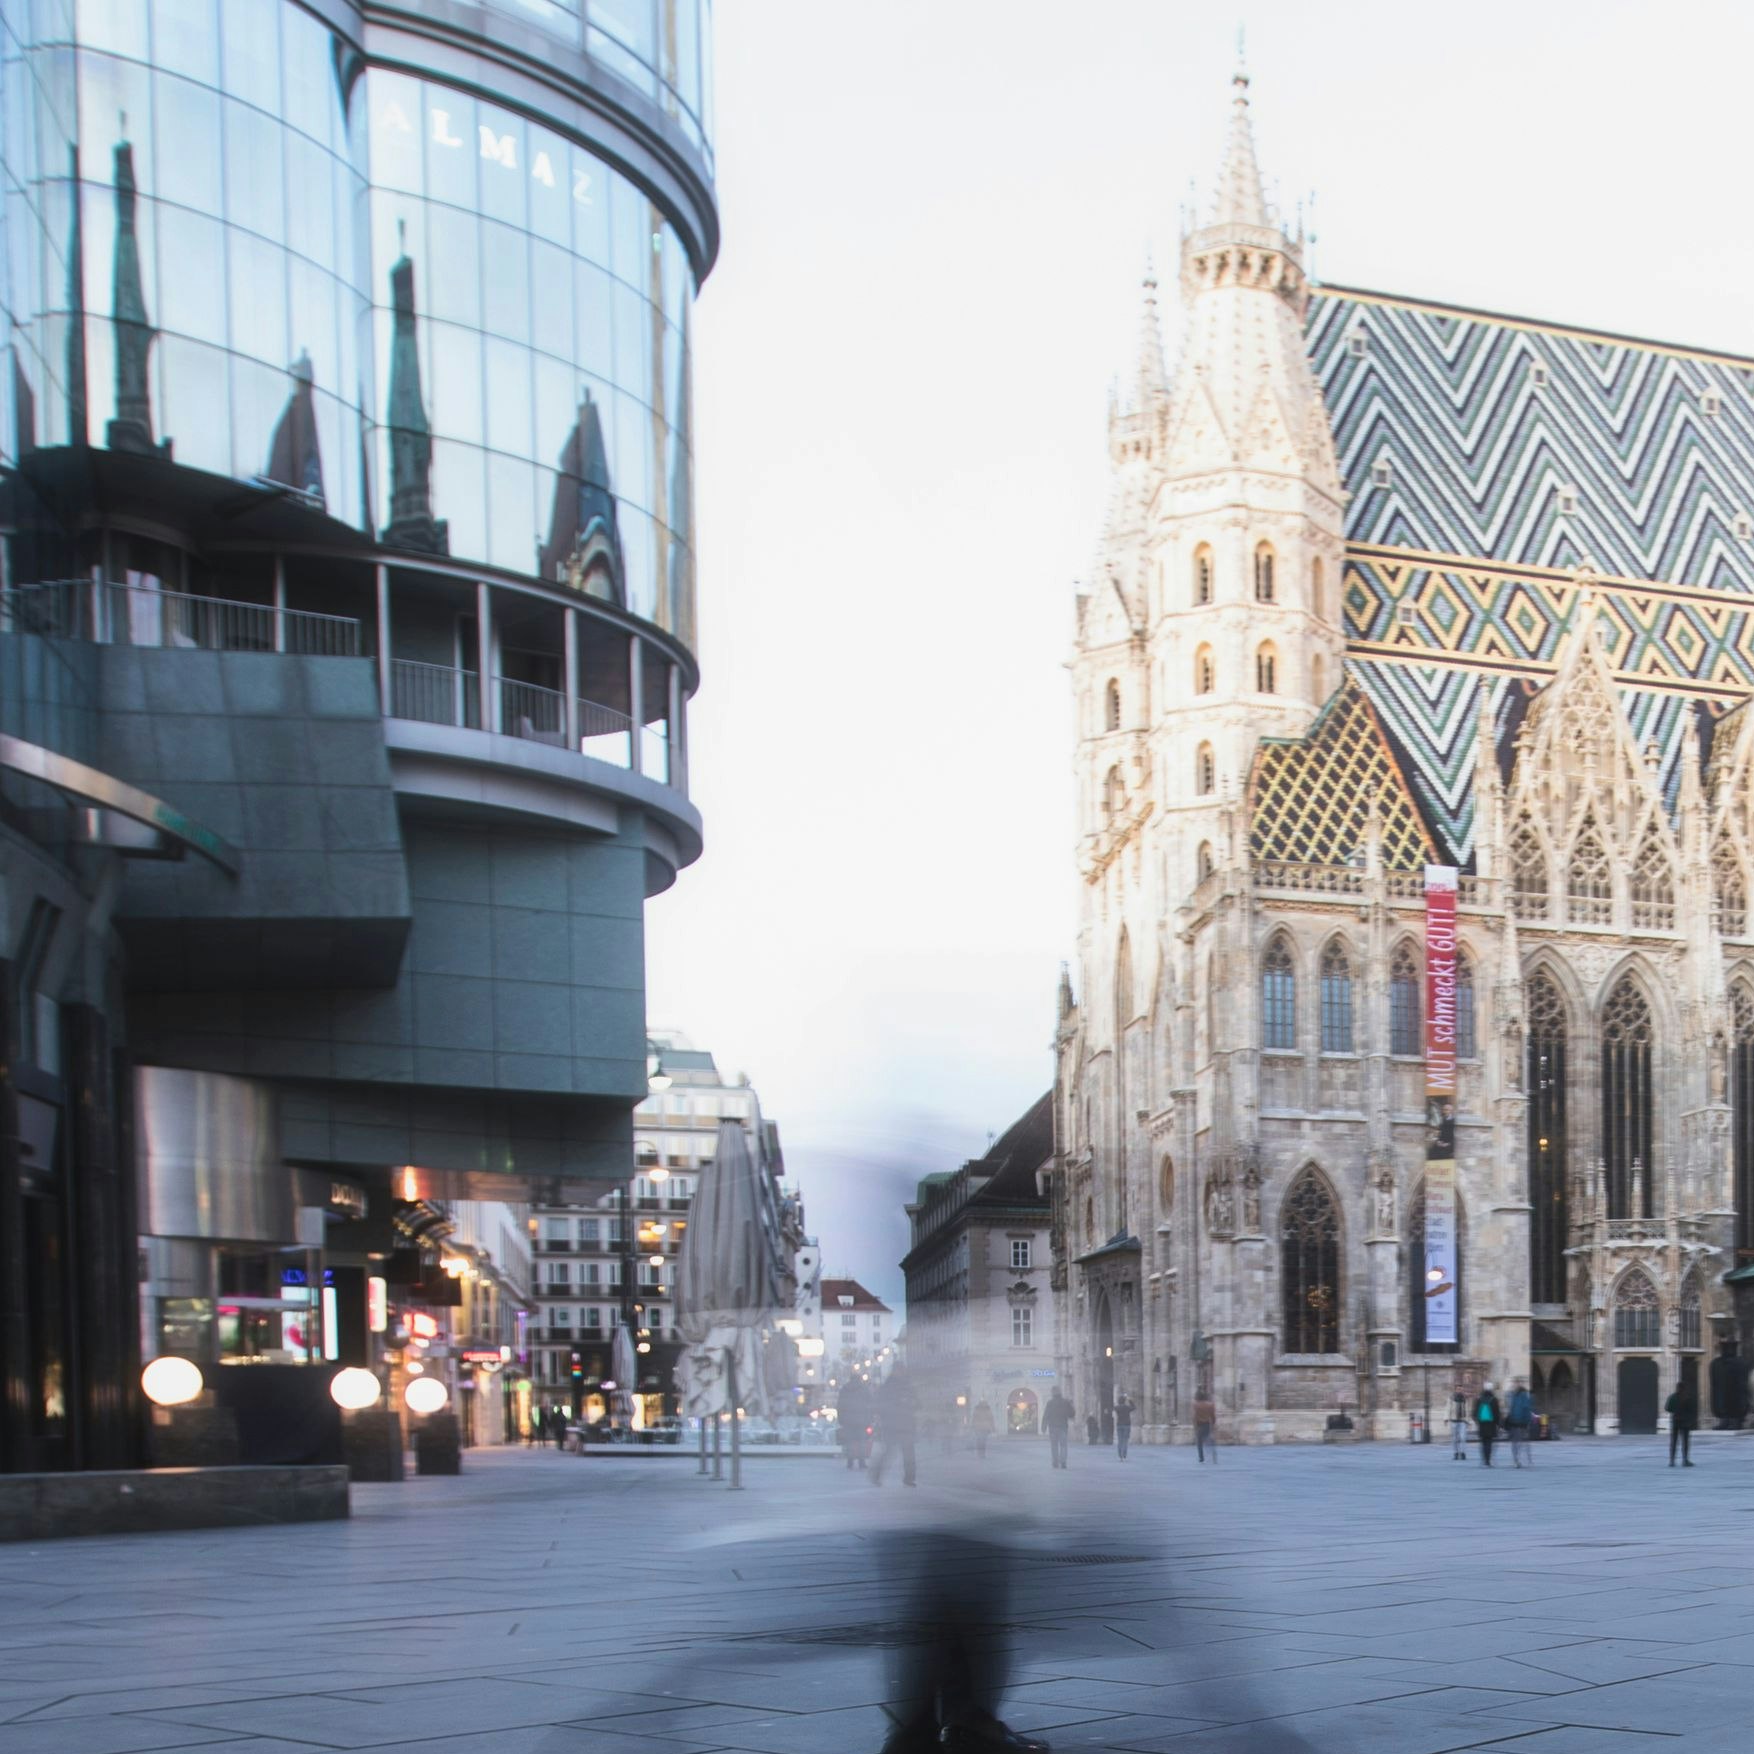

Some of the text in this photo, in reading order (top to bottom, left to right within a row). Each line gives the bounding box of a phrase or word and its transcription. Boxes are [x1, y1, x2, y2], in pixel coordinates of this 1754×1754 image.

[383, 101, 594, 205] ALMAZ
[1426, 908, 1456, 952] GUT!
[1426, 958, 1456, 1044] schmeckt
[1426, 1046, 1456, 1090] MUT
